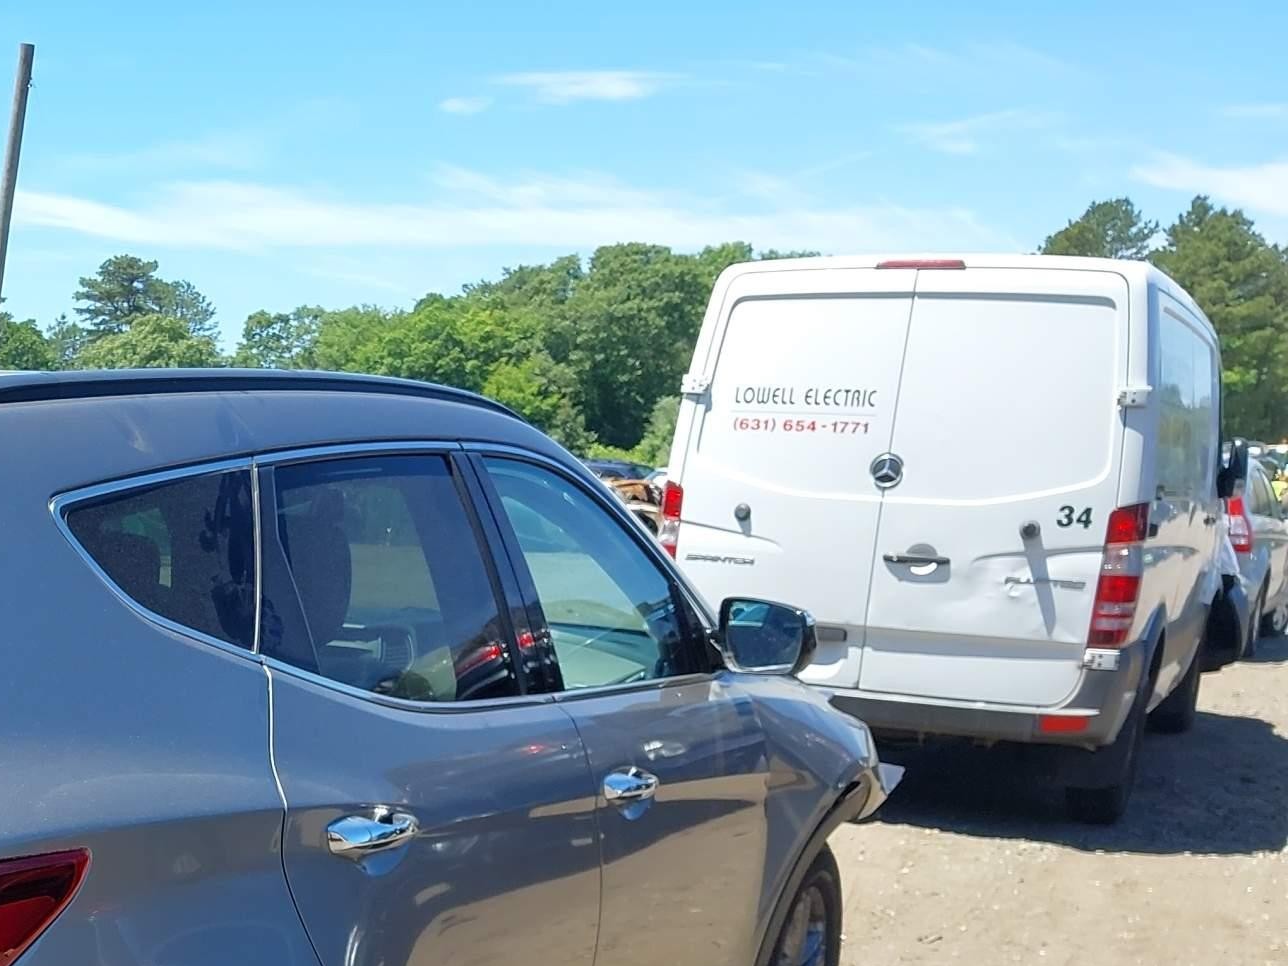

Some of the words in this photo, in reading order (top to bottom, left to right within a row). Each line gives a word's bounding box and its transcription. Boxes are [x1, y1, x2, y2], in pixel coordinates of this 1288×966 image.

[735, 387, 795, 405] LOWELL
[804, 388, 878, 407] ELECTRIC
[733, 417, 777, 432] (631)
[1055, 505, 1093, 529] 34
